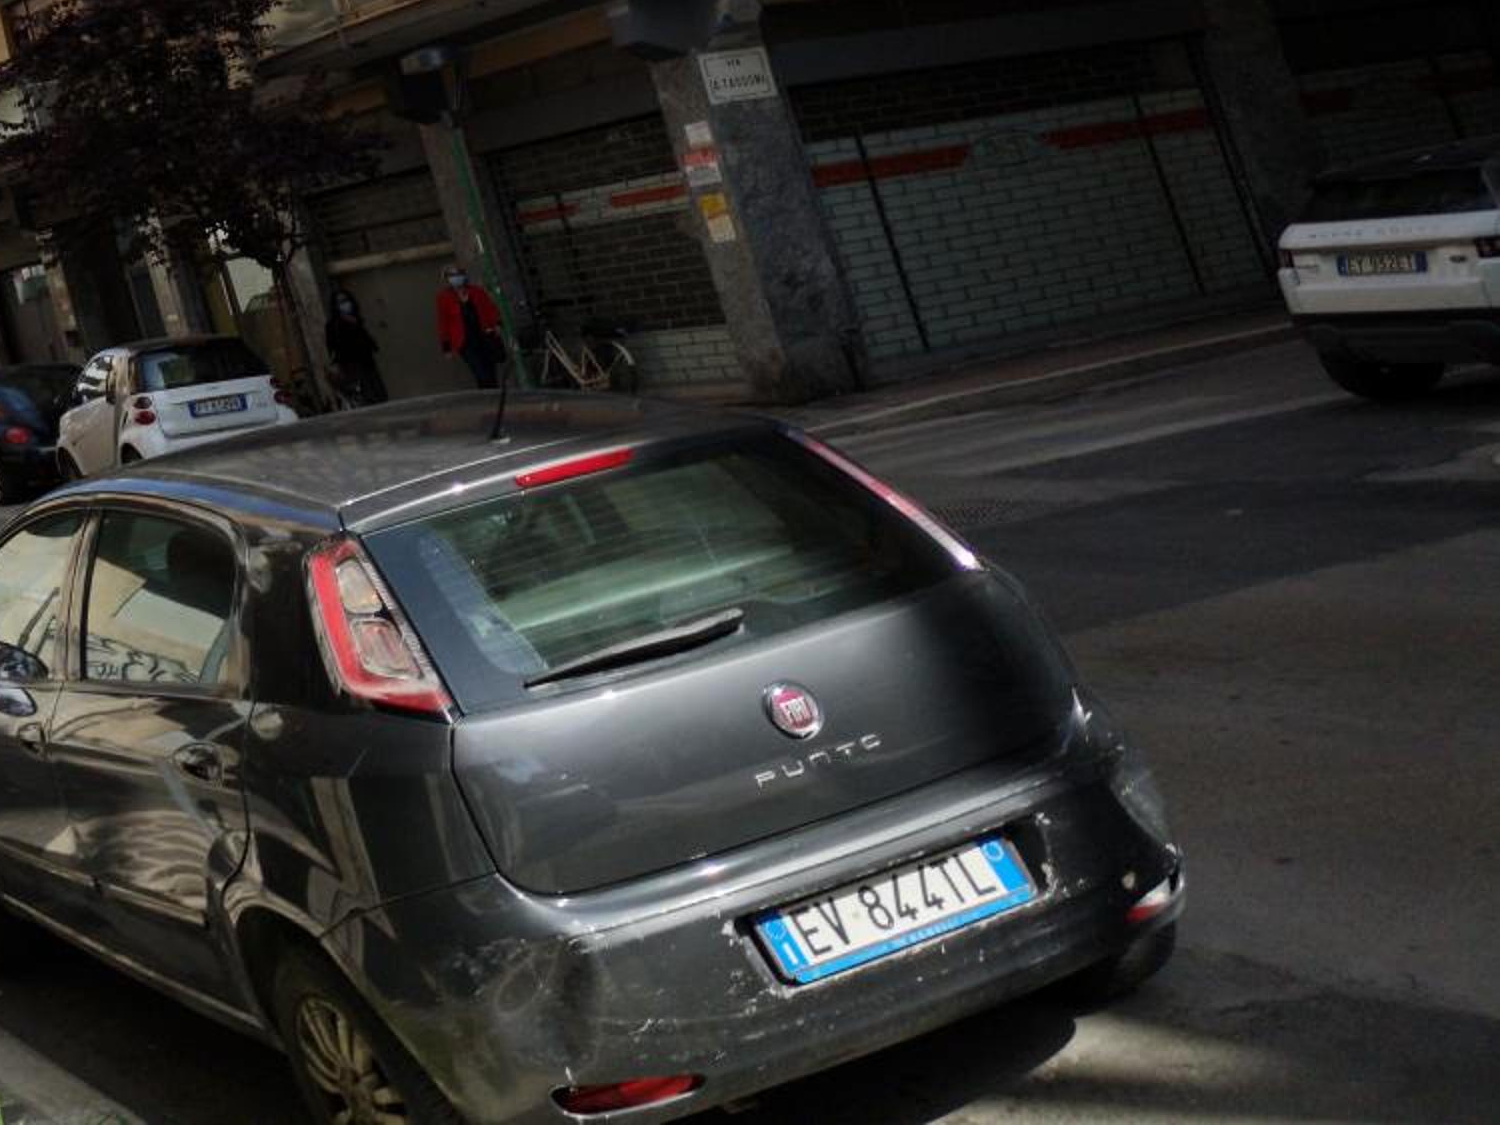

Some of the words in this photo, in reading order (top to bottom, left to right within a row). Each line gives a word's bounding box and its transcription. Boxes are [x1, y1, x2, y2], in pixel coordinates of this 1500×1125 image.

[754, 733, 882, 790] PUNTO
[787, 895, 850, 956] EV
[857, 852, 997, 931] 844TL
